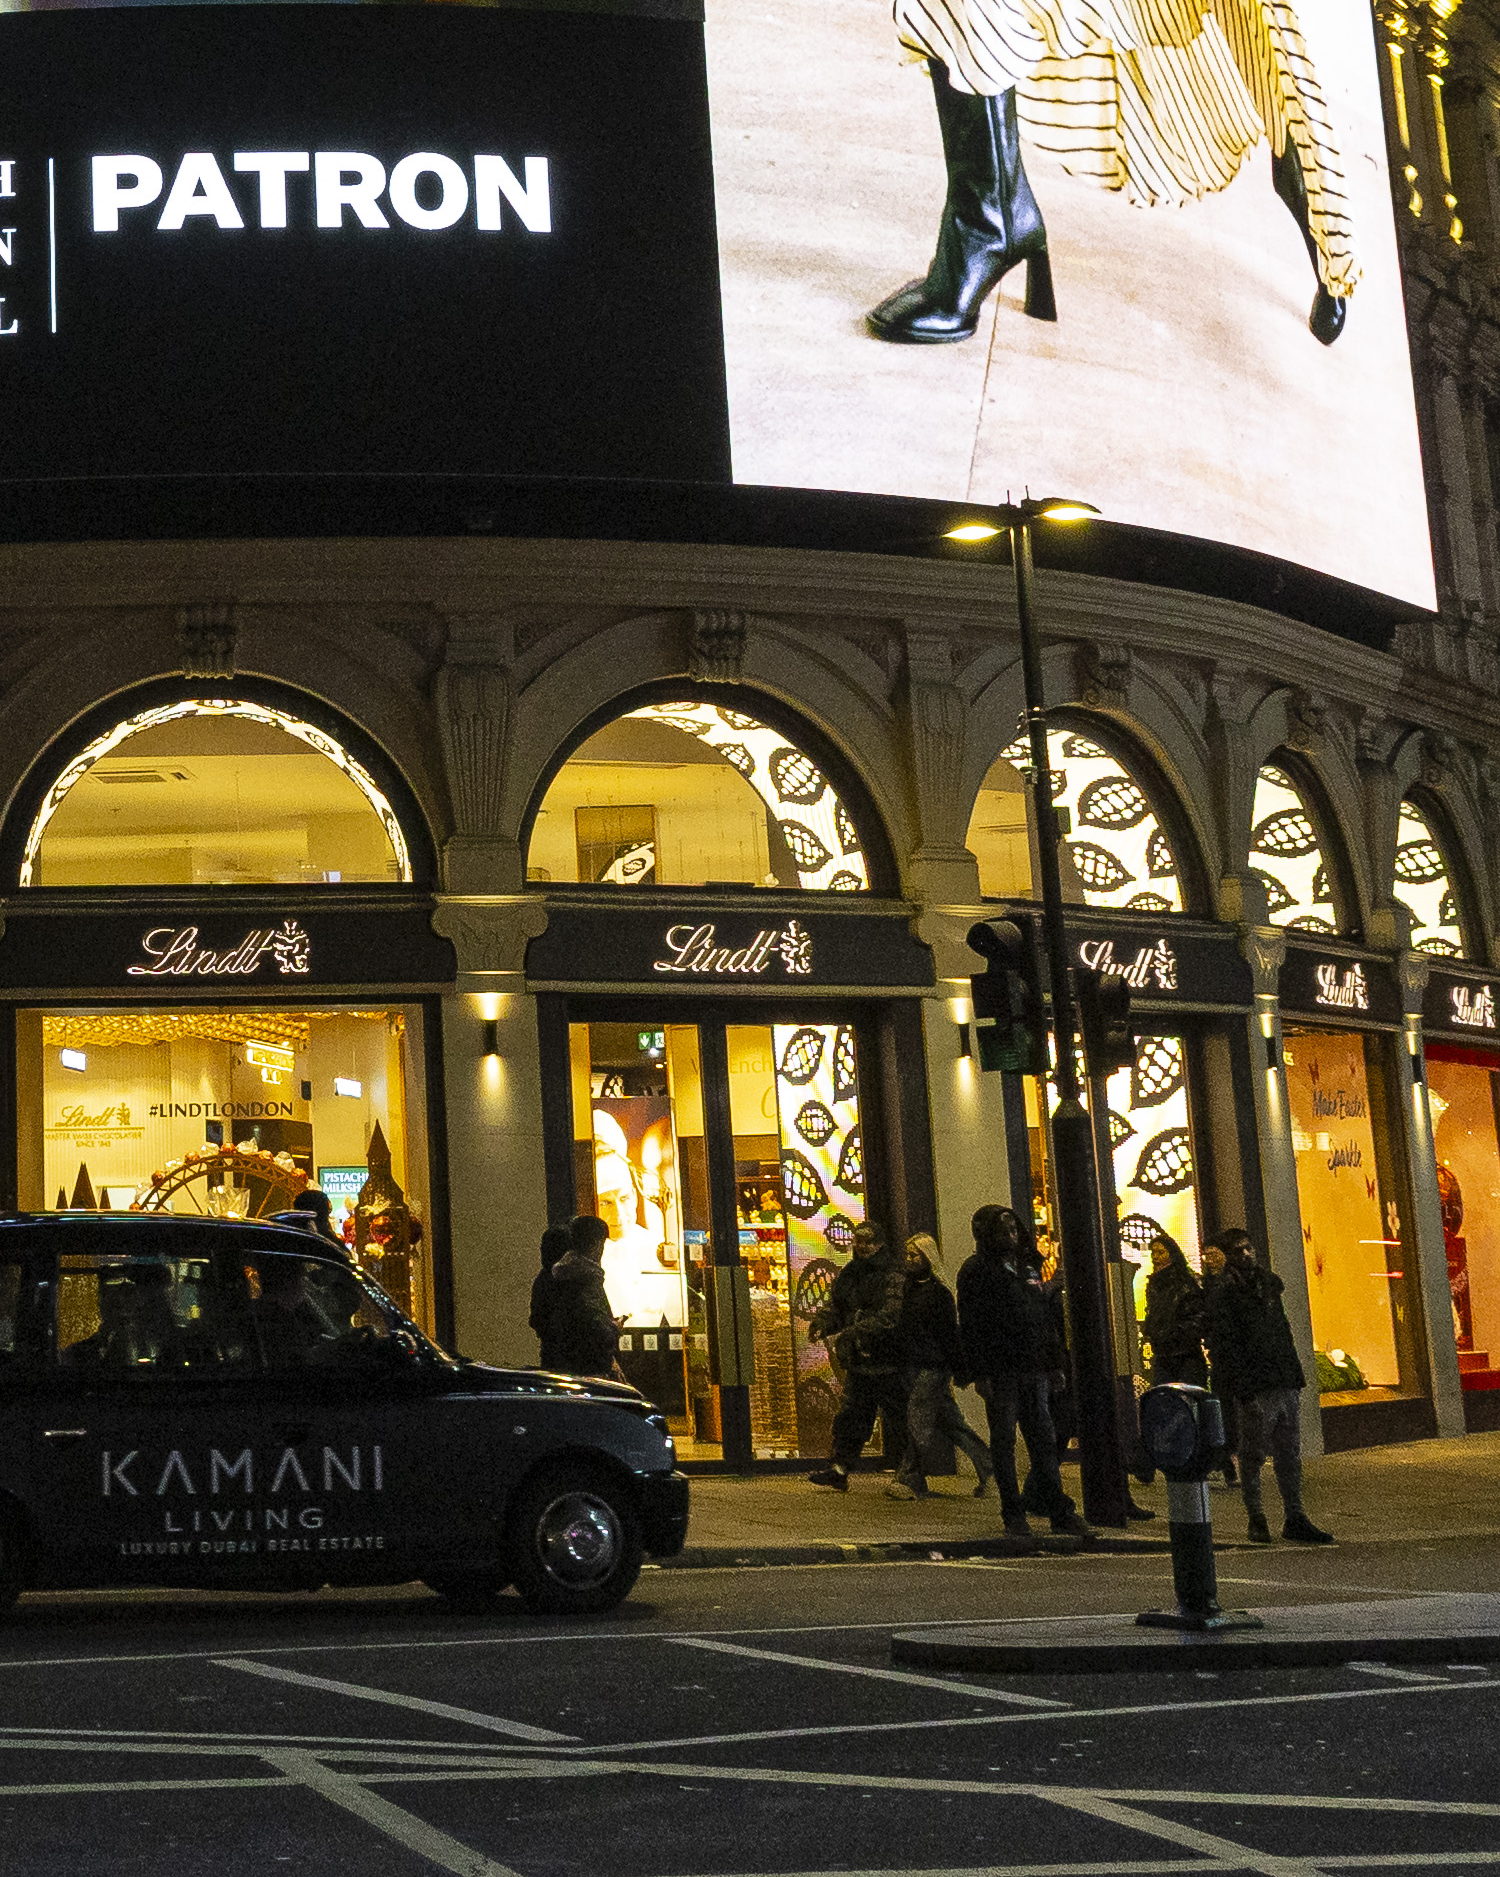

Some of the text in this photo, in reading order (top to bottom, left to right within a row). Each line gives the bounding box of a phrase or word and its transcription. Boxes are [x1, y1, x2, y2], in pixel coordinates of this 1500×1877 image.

[91, 150, 553, 234] PATRON
[126, 926, 277, 976] Lindt
[652, 923, 781, 974] Lindt
[1079, 940, 1154, 988] Lindt
[1315, 963, 1355, 1008] Lindt
[54, 1104, 116, 1127] Lindt
[148, 1101, 294, 1119] #LINDTLONDON
[45, 1131, 71, 1141] MASTER
[76, 1140, 96, 1148] SINCE
[322, 1183, 362, 1194] MILKSH
[102, 1445, 384, 1496] KAMANI
[165, 1507, 324, 1533] LIVING
[120, 1536, 385, 1555] LUXURY DUBAI REAL ESTATE
